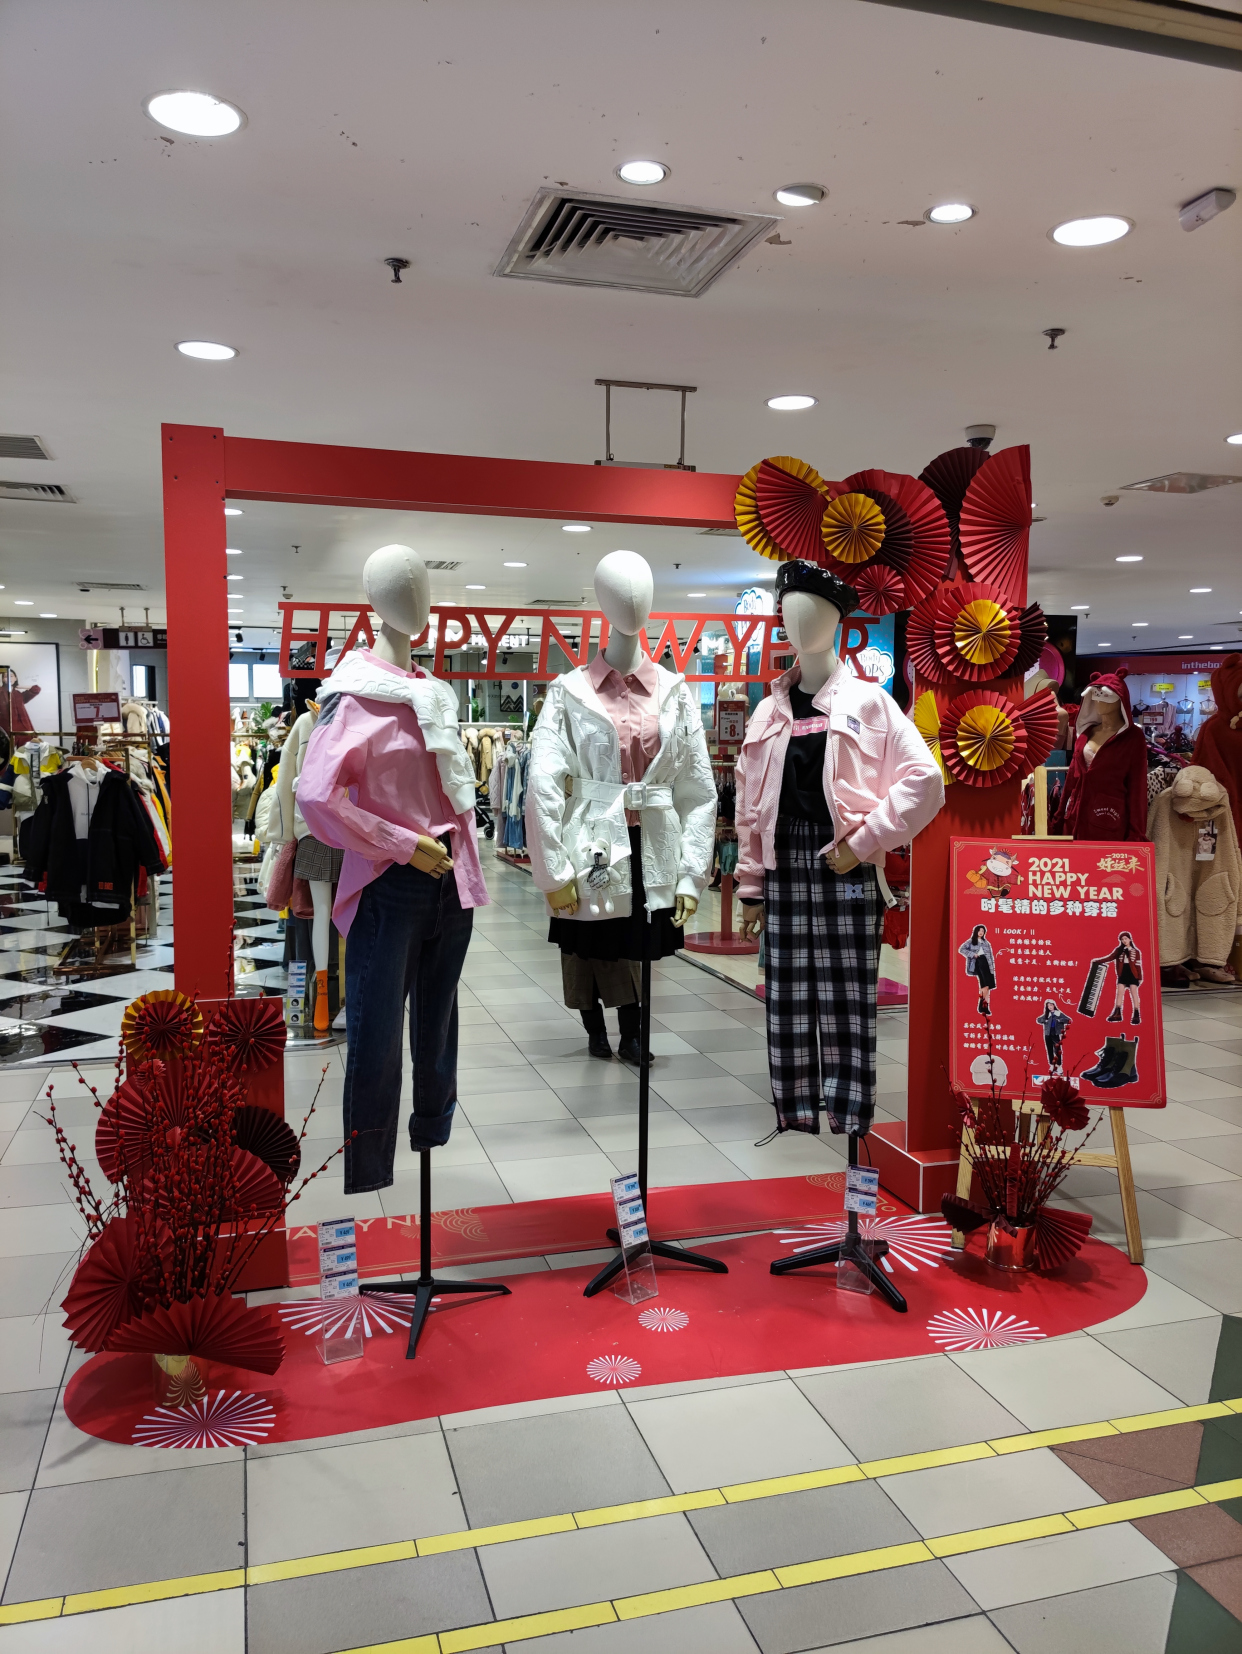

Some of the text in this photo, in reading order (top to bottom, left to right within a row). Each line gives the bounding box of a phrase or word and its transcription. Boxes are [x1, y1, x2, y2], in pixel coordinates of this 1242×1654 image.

[278, 602, 881, 684] HAPY NW YER
[1182, 661, 1222, 669] inthebo
[1028, 858, 1069, 871] 2021
[1028, 872, 1089, 885] HAPPY
[1028, 885, 1124, 900] NEW YEAR
[981, 898, 1118, 917] 时髦精的多种穿搭
